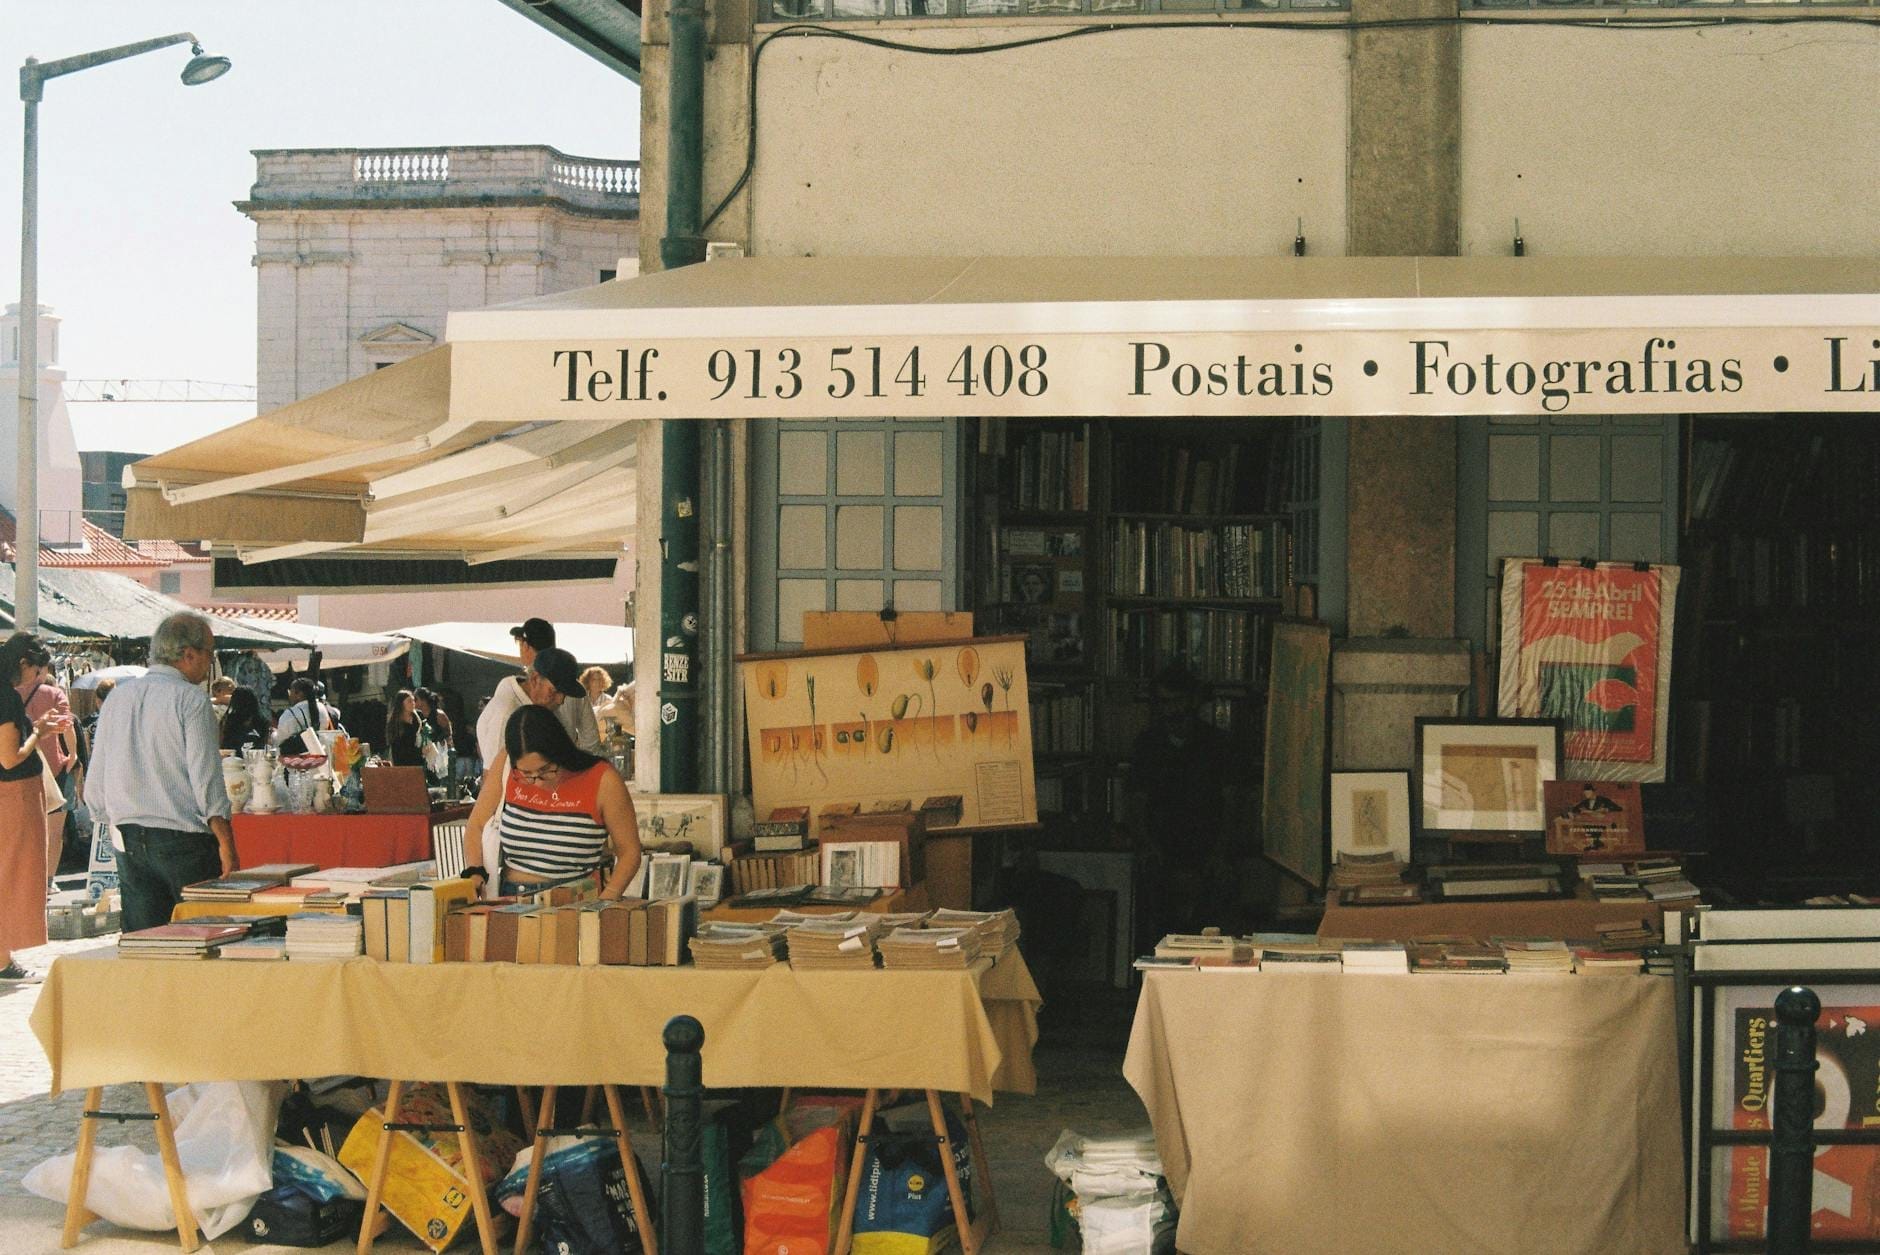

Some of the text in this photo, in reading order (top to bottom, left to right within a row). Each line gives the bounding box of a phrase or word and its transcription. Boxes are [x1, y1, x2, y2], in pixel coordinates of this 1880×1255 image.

[553, 348, 667, 402] Telf.
[708, 349, 803, 400] 913
[827, 346, 926, 399] 514
[946, 345, 1049, 398] 408
[1127, 341, 1334, 397] Postais
[1409, 338, 1744, 412] Fotografias
[1549, 602, 1633, 621] SEMPRE!
[1594, 582, 1642, 602] Abril
[1741, 1016, 1767, 1112] Quartiers
[868, 1157, 881, 1221] www.lidlplu
